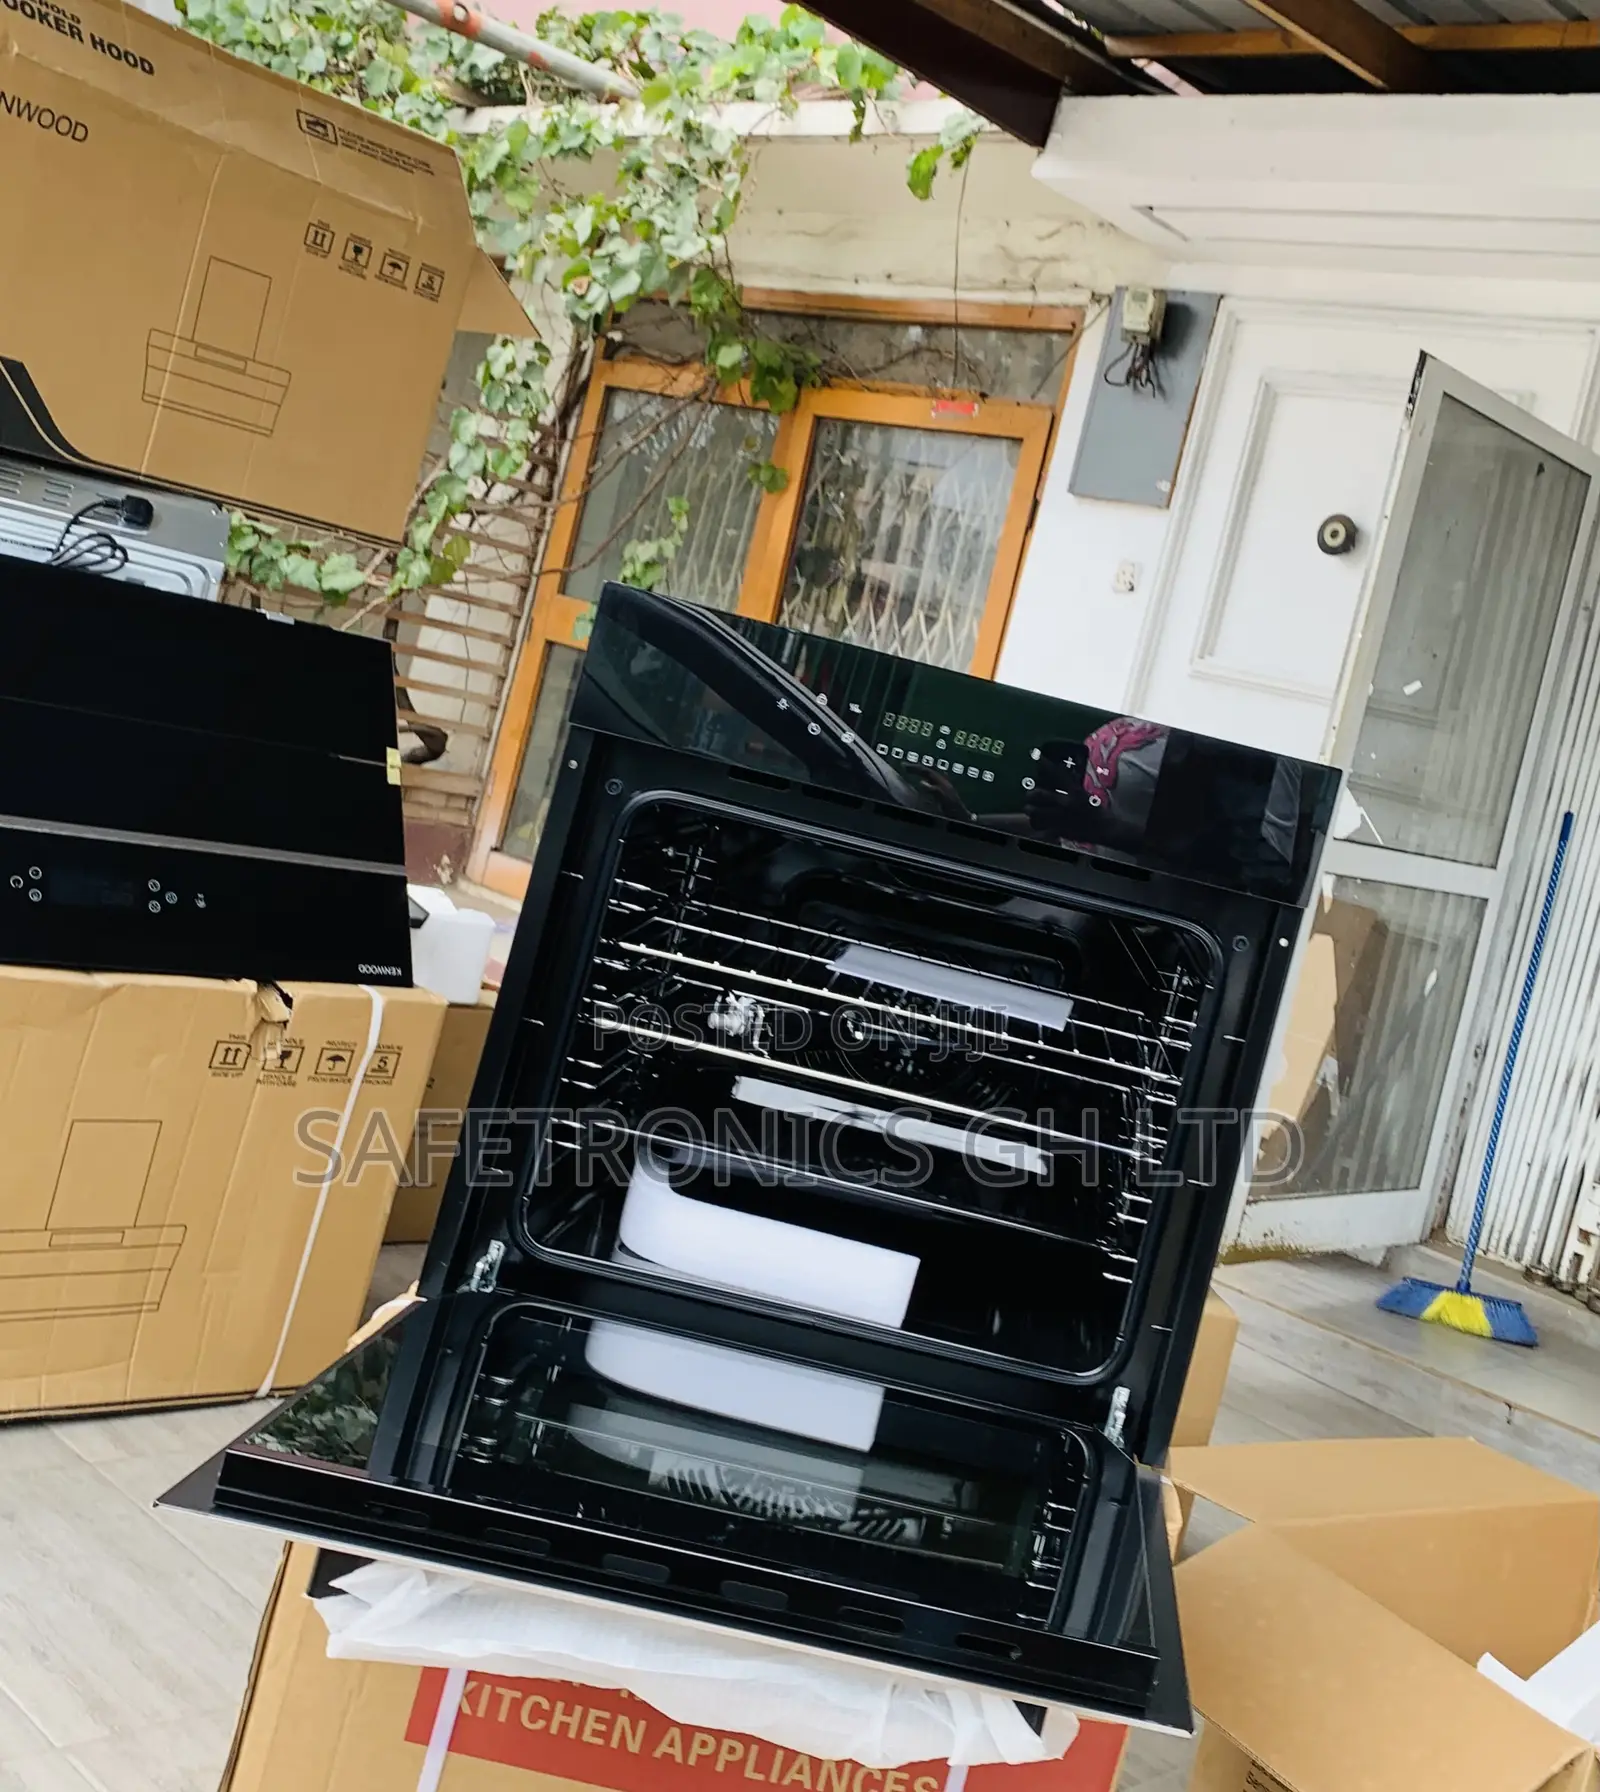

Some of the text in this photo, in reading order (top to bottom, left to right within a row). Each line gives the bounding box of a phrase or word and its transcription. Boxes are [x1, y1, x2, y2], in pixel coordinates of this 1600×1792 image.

[89, 32, 155, 76] HOOD
[357, 963, 402, 977] KENWOOD
[459, 1680, 940, 1792] KITCHEN APPLIANCES
